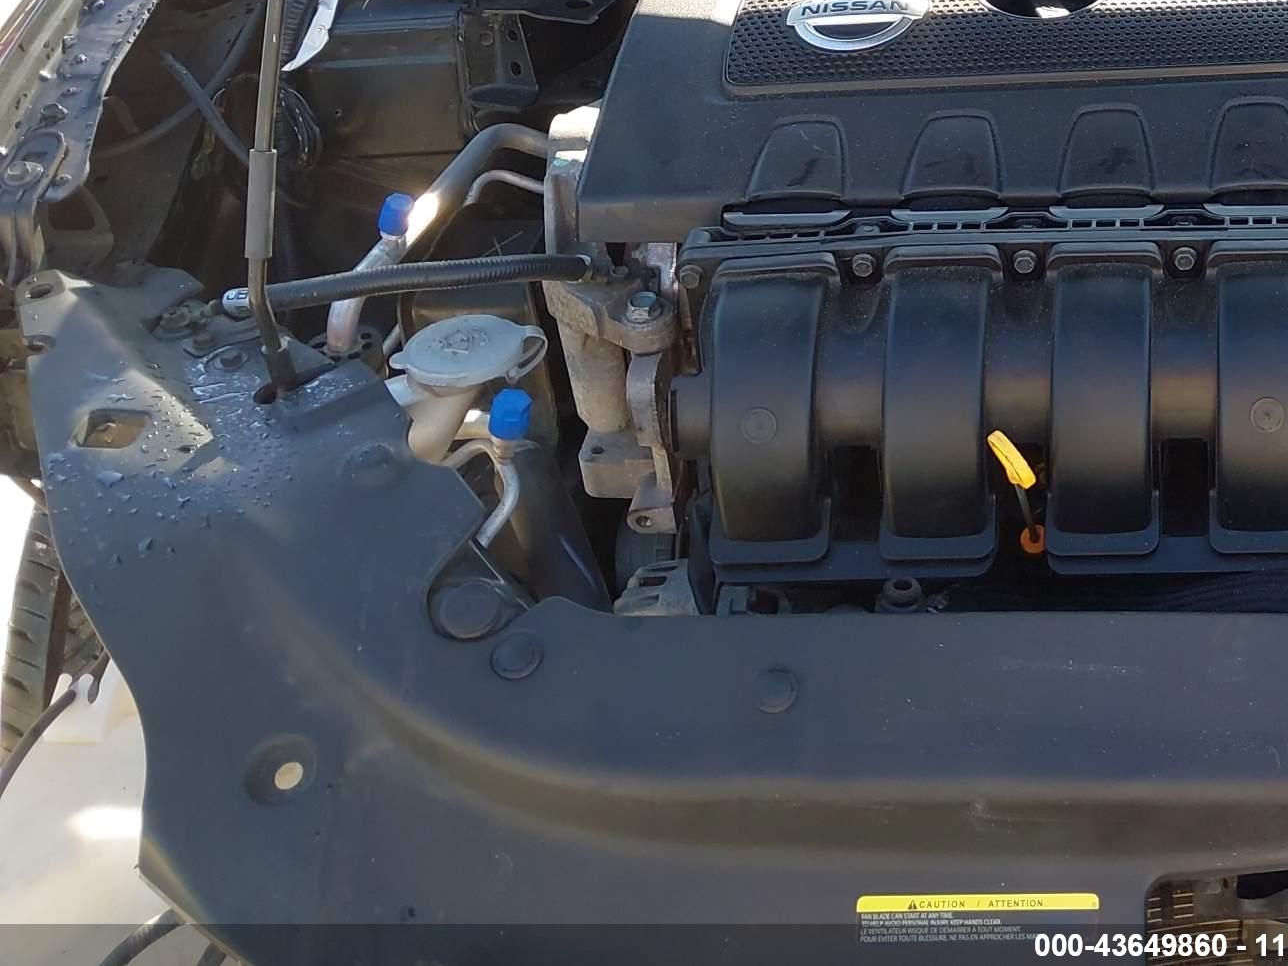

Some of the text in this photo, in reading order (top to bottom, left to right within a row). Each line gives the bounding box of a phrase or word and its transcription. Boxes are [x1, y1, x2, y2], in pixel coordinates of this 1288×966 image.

[801, 0, 909, 16] NISSAN
[919, 900, 966, 909] CAUTION
[988, 899, 1044, 908] ATTENTION
